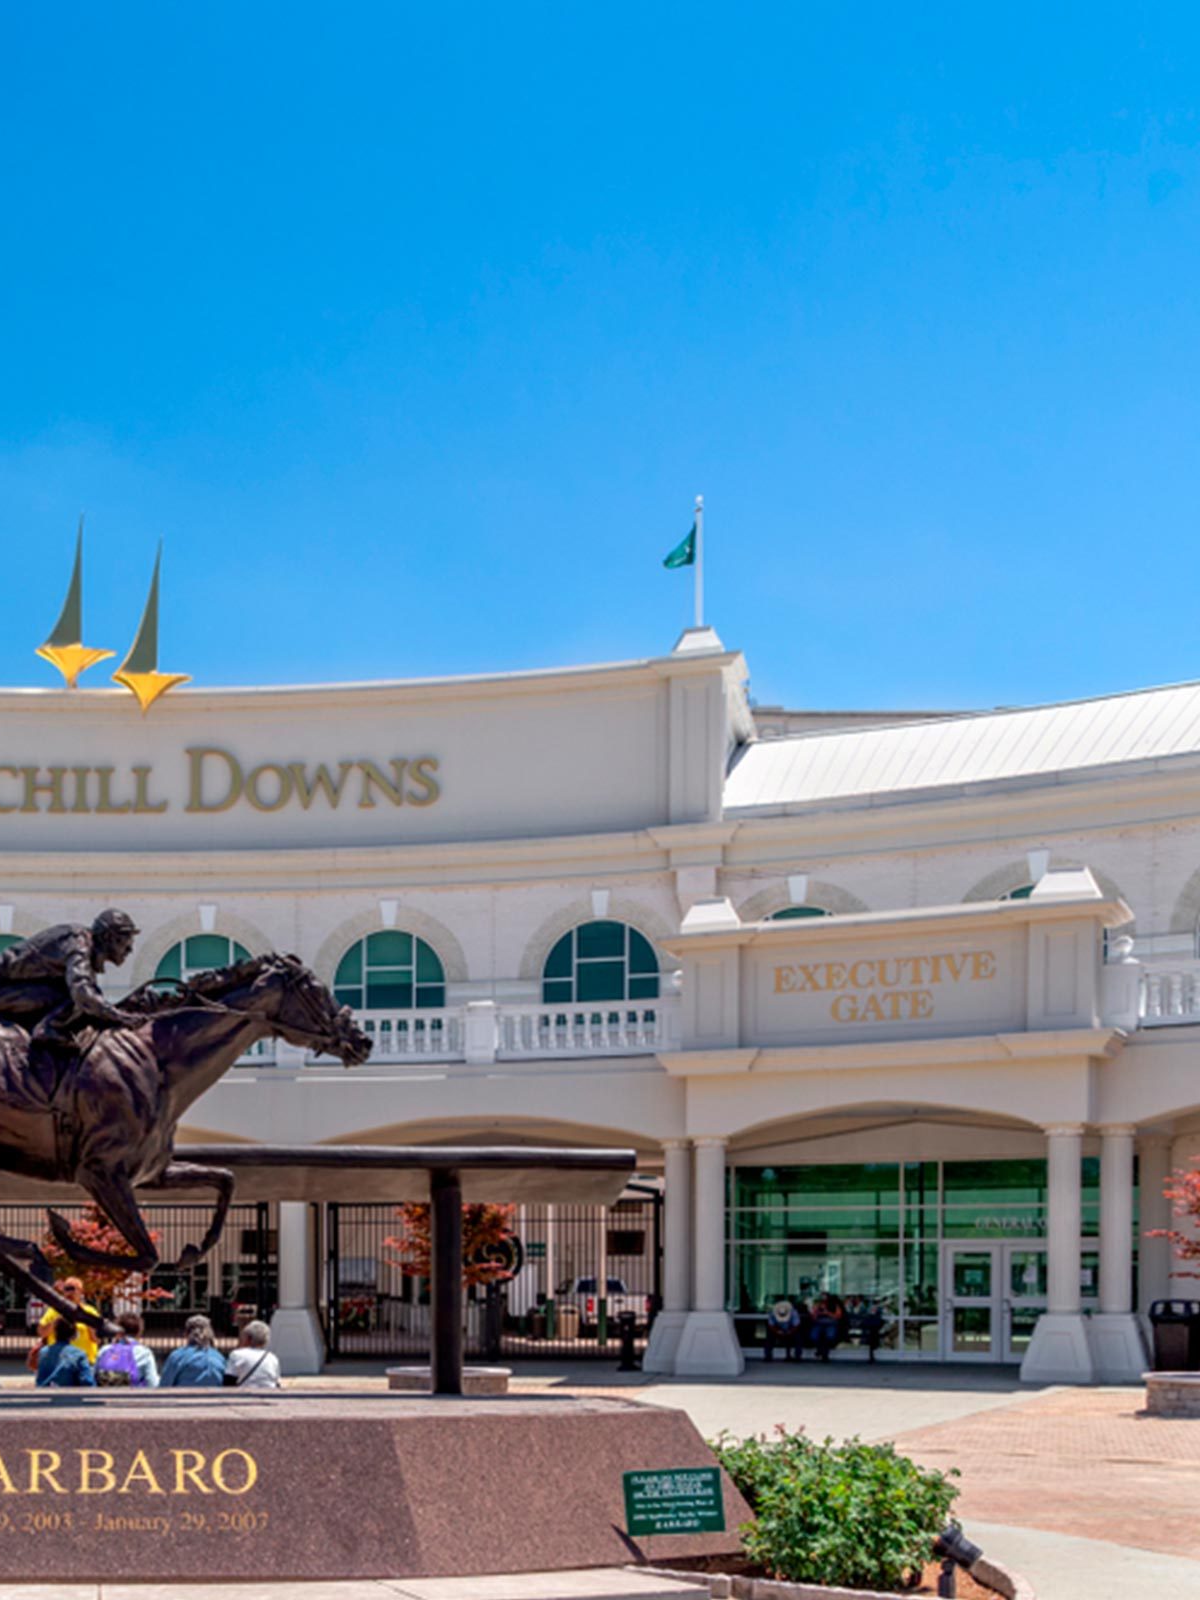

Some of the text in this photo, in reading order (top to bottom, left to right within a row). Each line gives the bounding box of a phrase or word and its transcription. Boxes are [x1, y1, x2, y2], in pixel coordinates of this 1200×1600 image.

[184, 746, 441, 814] DOWNS
[773, 950, 996, 994] EXECUTIVE
[830, 990, 935, 1023] GATE
[94, 1512, 170, 1537] January
[179, 1511, 212, 1534] 29,
[217, 1511, 269, 1532] 2007
